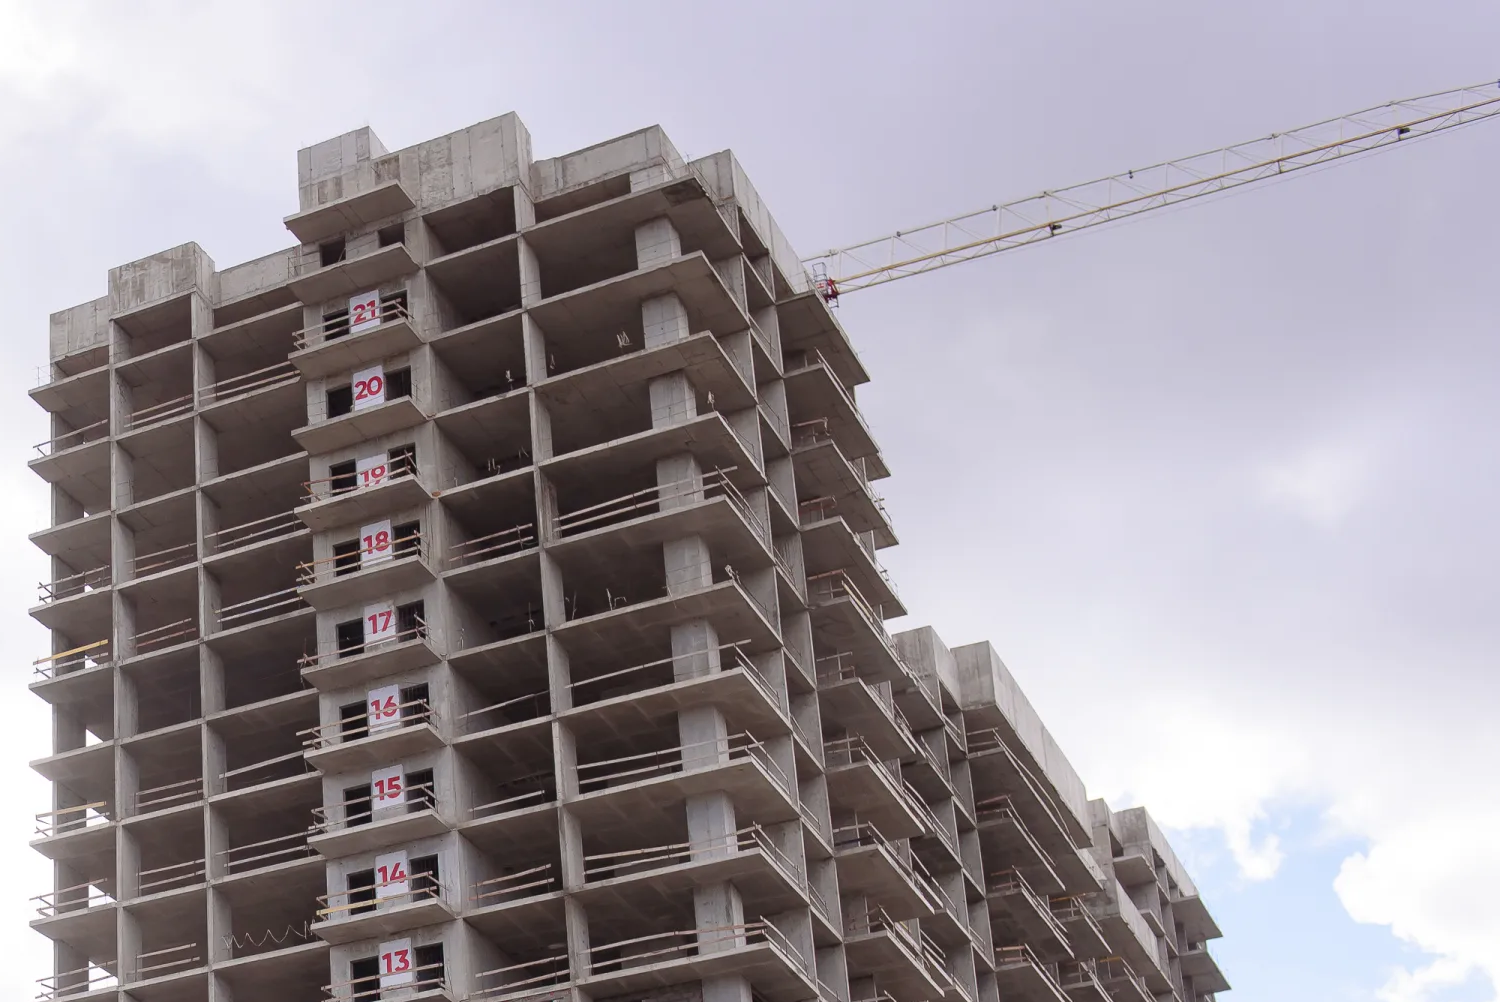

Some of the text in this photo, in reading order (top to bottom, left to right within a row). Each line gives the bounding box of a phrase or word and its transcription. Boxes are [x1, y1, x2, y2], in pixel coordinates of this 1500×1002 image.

[353, 300, 377, 324] 21
[355, 375, 384, 401] 20
[360, 464, 386, 487] 19
[363, 530, 389, 555] 18
[367, 610, 392, 634] 17
[371, 695, 397, 720] 16
[374, 775, 402, 802] 15
[377, 862, 407, 887] 14
[381, 948, 410, 974] 13
